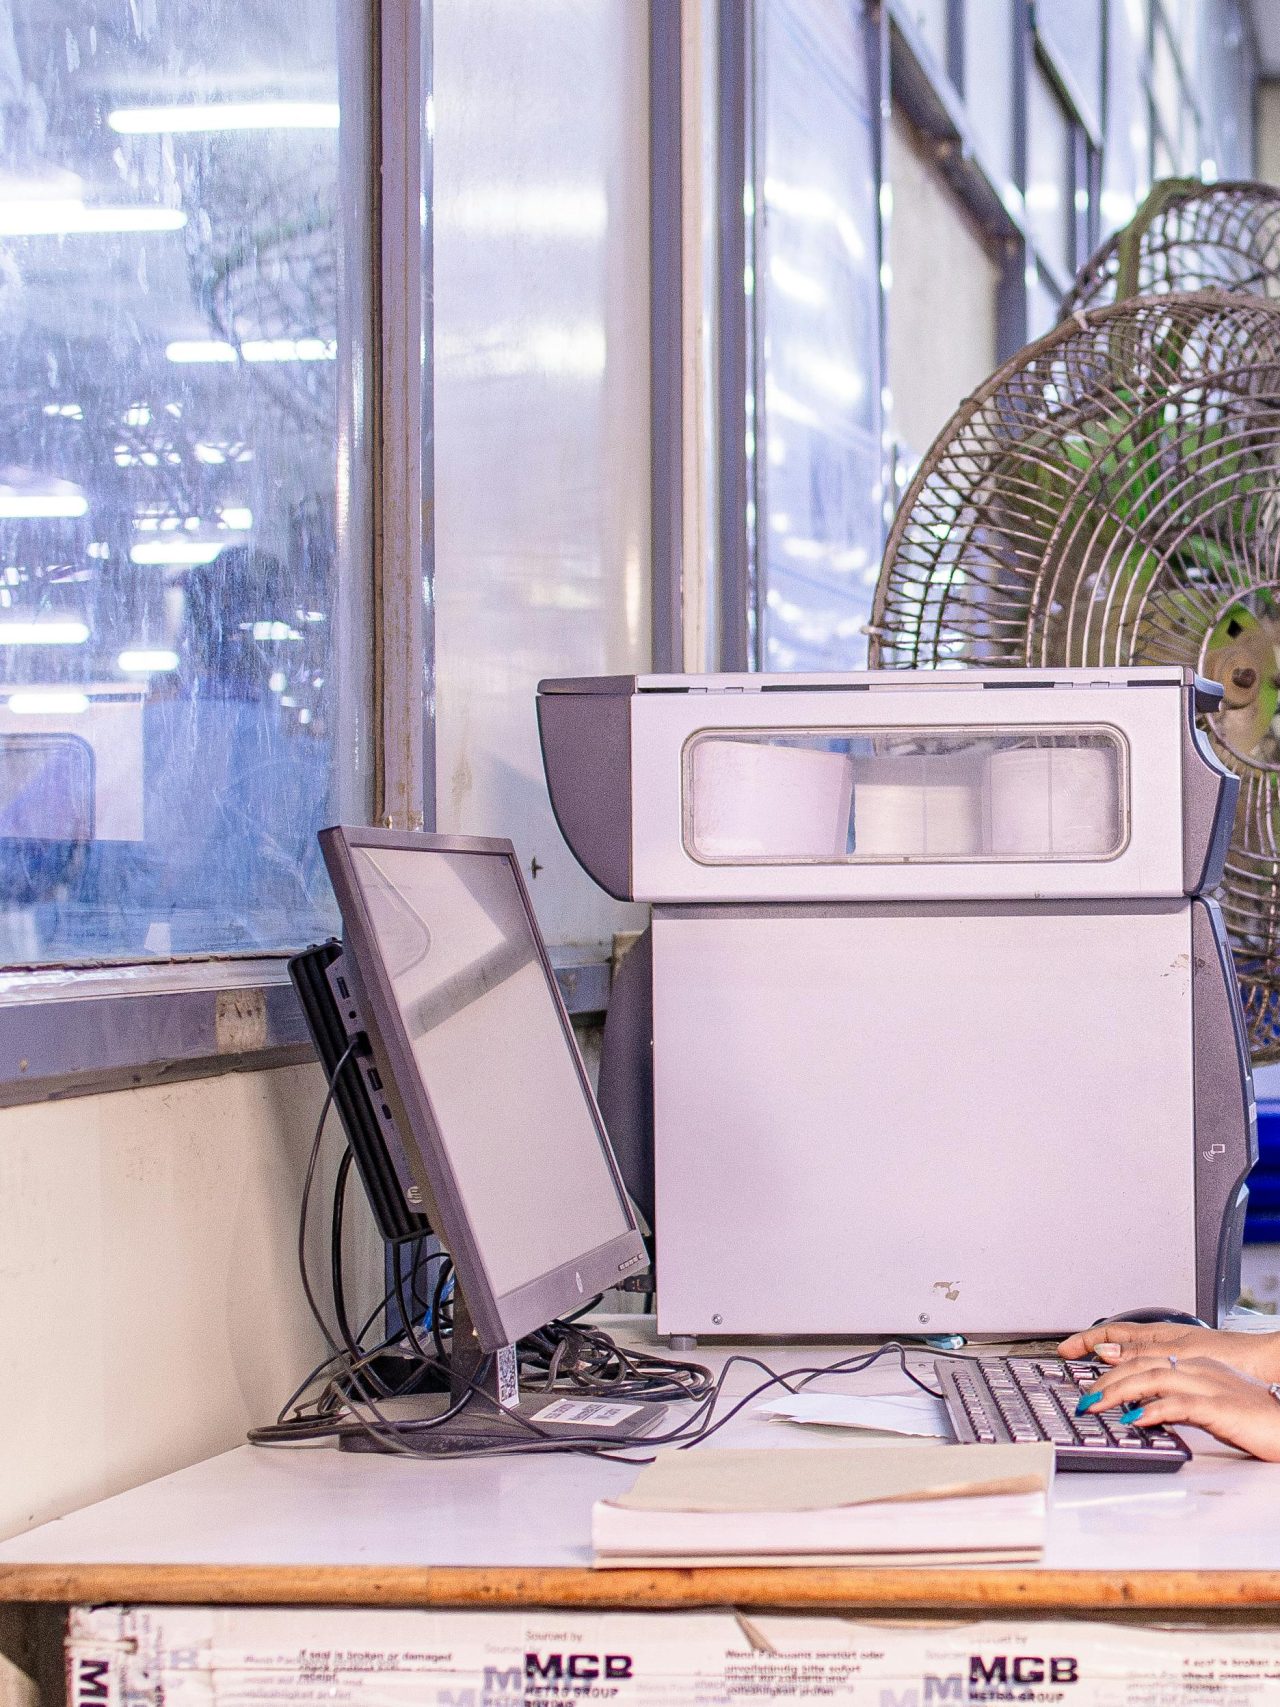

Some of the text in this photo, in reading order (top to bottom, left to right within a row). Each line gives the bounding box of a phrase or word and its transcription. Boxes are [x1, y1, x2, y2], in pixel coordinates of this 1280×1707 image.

[402, 1652, 453, 1664] damaged
[525, 1653, 633, 1679] MGB
[970, 1656, 1079, 1684] MGB
